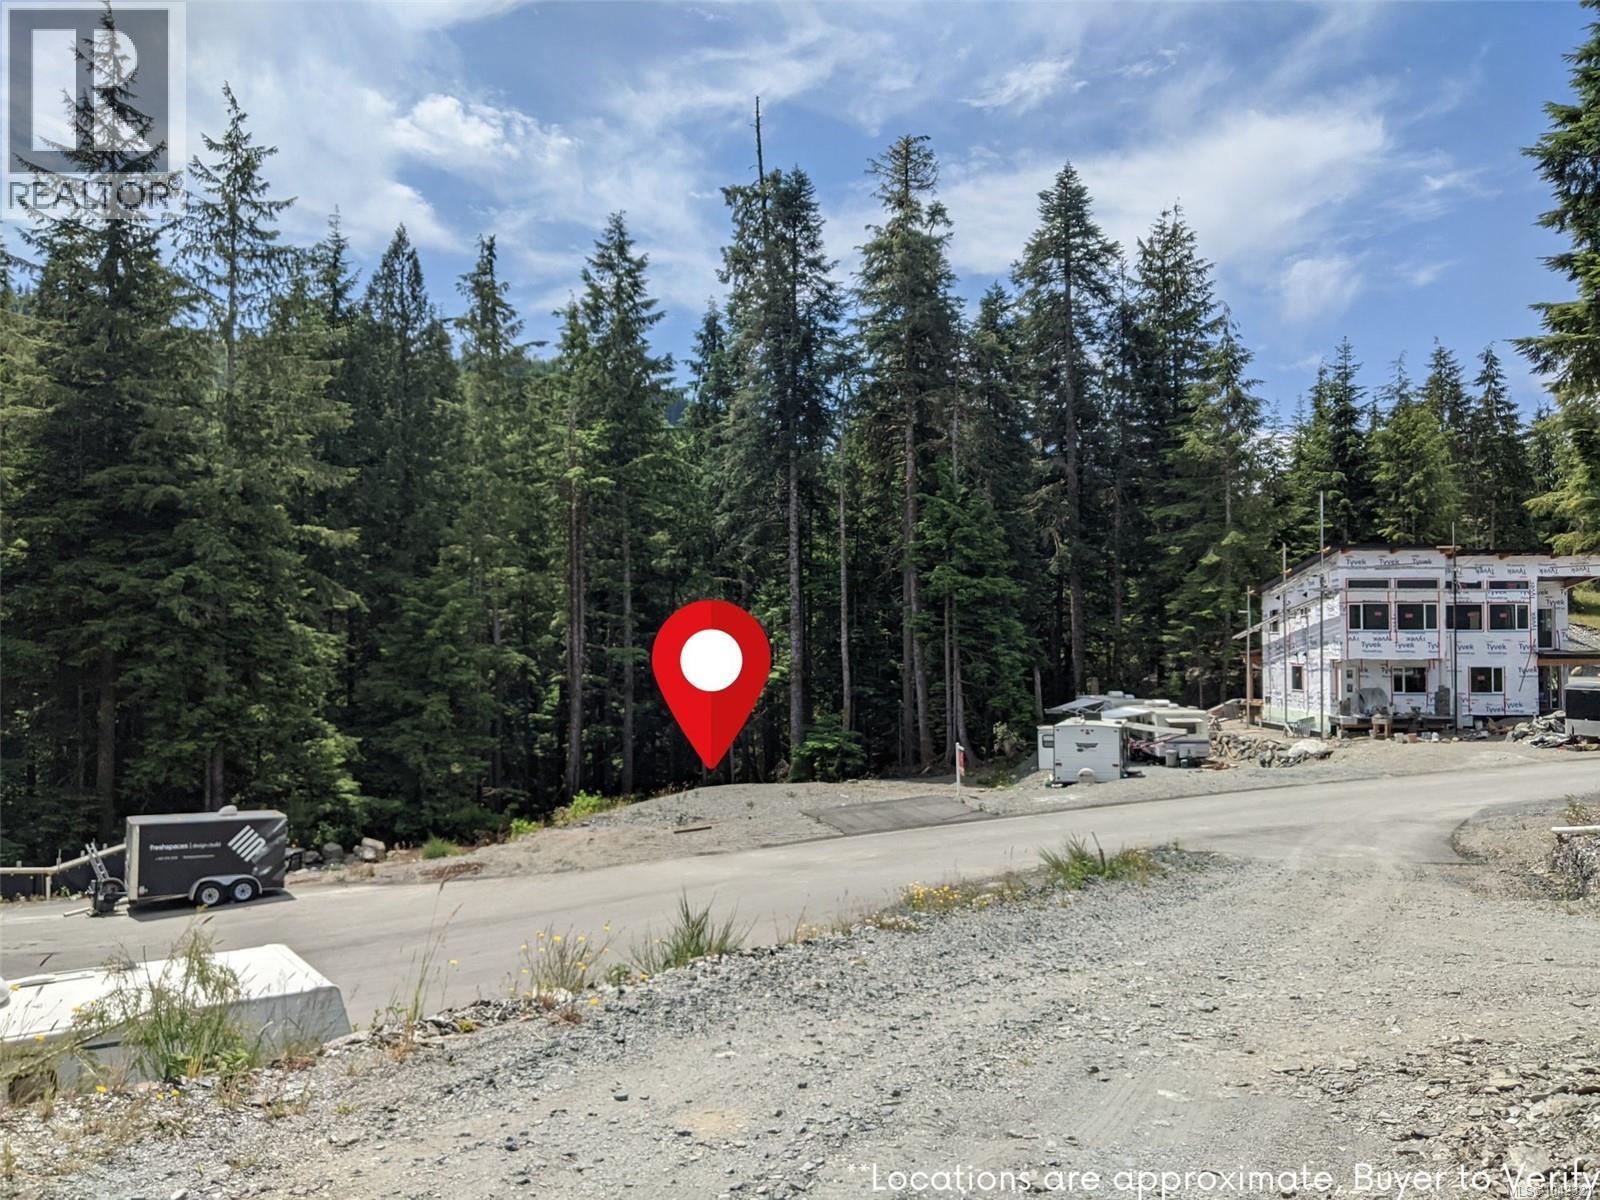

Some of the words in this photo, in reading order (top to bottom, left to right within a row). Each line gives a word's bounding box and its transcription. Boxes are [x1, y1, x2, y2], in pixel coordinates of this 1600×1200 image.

[1346, 558, 1366, 566] Tyvek
[1379, 558, 1400, 566] Tyvek
[1412, 558, 1432, 566] Tyvek
[1507, 567, 1527, 575] Tyvek
[1361, 641, 1381, 649] Tyvek
[1395, 641, 1415, 649] Tyvek
[1518, 666, 1537, 674] Tyvek
